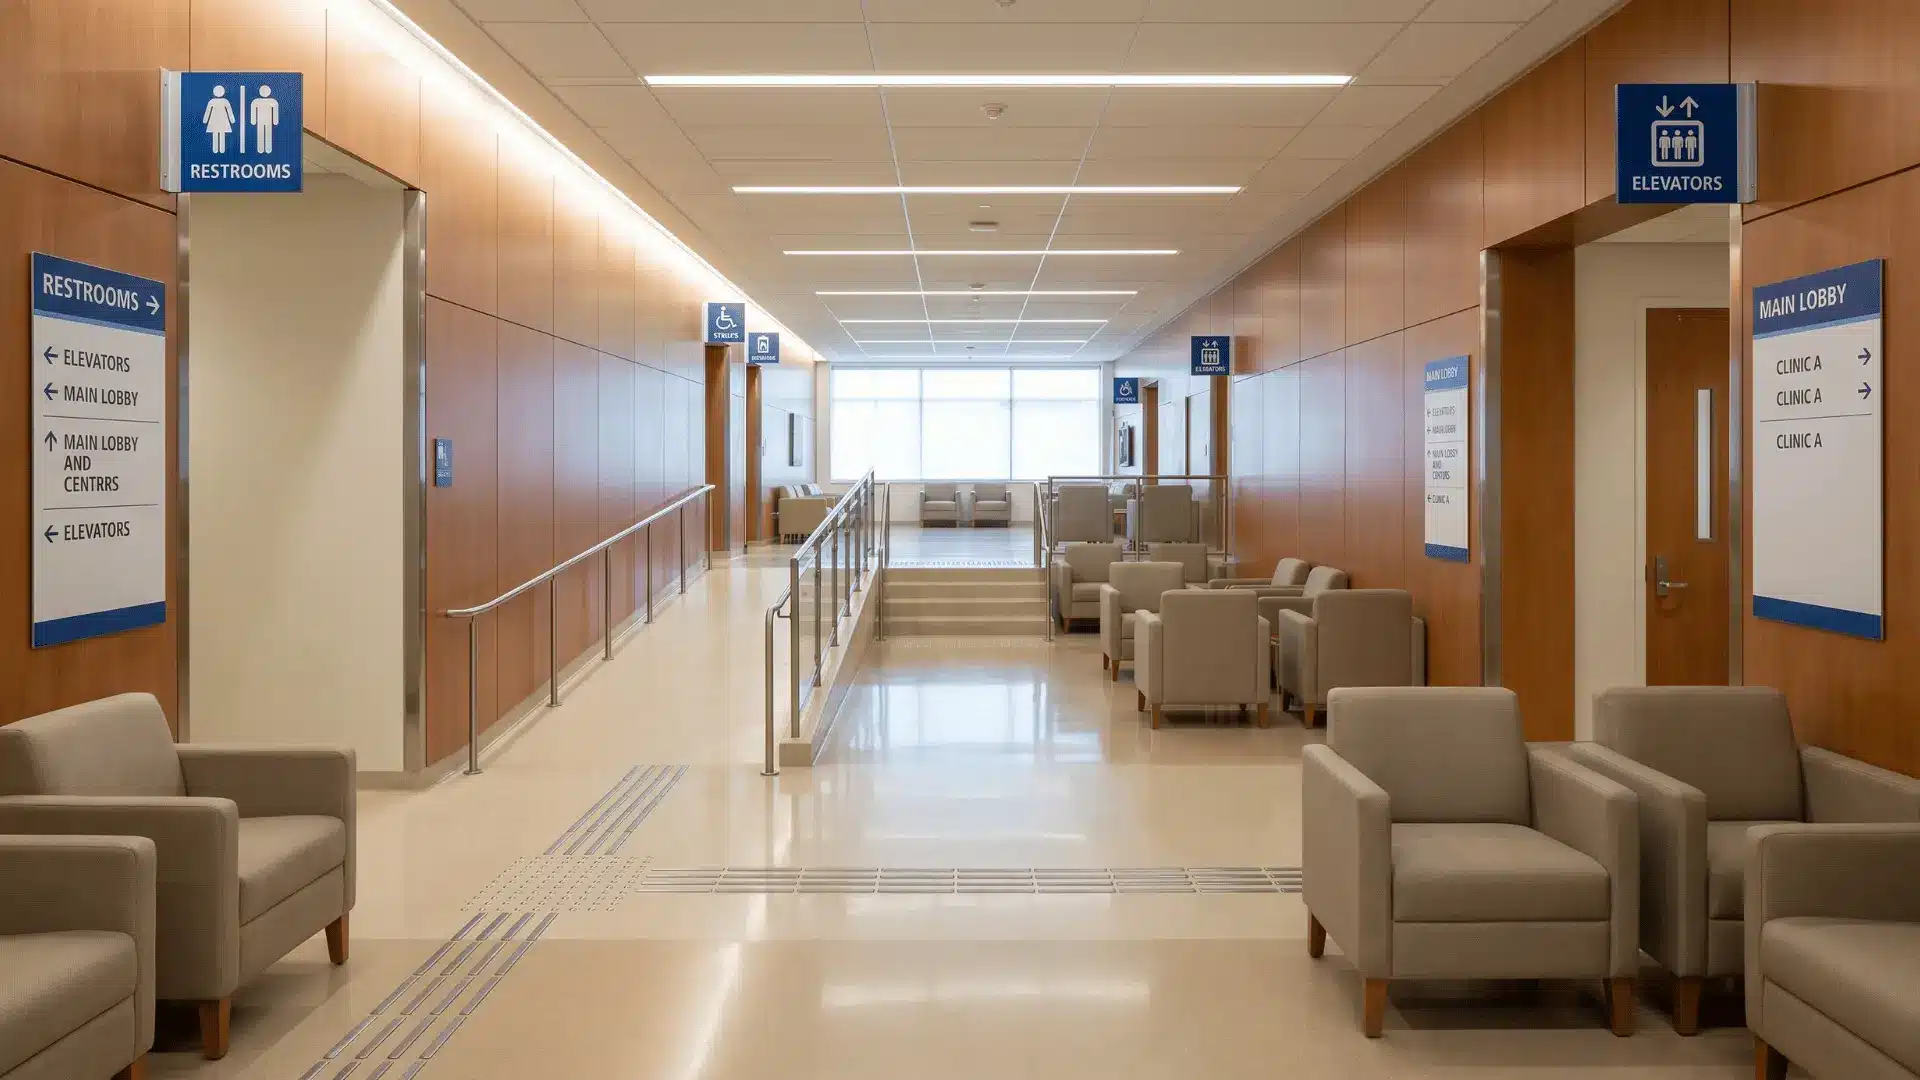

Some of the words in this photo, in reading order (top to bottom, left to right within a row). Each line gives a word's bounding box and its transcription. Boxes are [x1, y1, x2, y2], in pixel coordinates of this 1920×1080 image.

[190, 164, 291, 179] RESTROOMS
[1632, 176, 1723, 191] ELEVATORS
[43, 273, 139, 311] RESTROOMS
[1759, 295, 1795, 319] MAIN
[1799, 283, 1847, 312] LOBBY
[64, 349, 131, 373] ELEVATORS
[1776, 356, 1811, 375] CLINIC
[1813, 355, 1822, 370] A
[1426, 371, 1441, 382] MAIN
[1441, 366, 1459, 380] LOBBY
[64, 385, 98, 403] MAIN
[101, 389, 139, 406] LOBBY
[1776, 388, 1811, 406] CLINIC
[1813, 388, 1822, 403] A
[64, 434, 98, 451] MAIN
[101, 436, 139, 452] LOBBY
[1776, 433, 1811, 449] CLINIC
[1813, 433, 1822, 448] A
[64, 455, 92, 471] AND
[64, 476, 119, 492] CENTRRS
[1446, 495, 1450, 504] A
[64, 521, 131, 541] ELEVATORS
